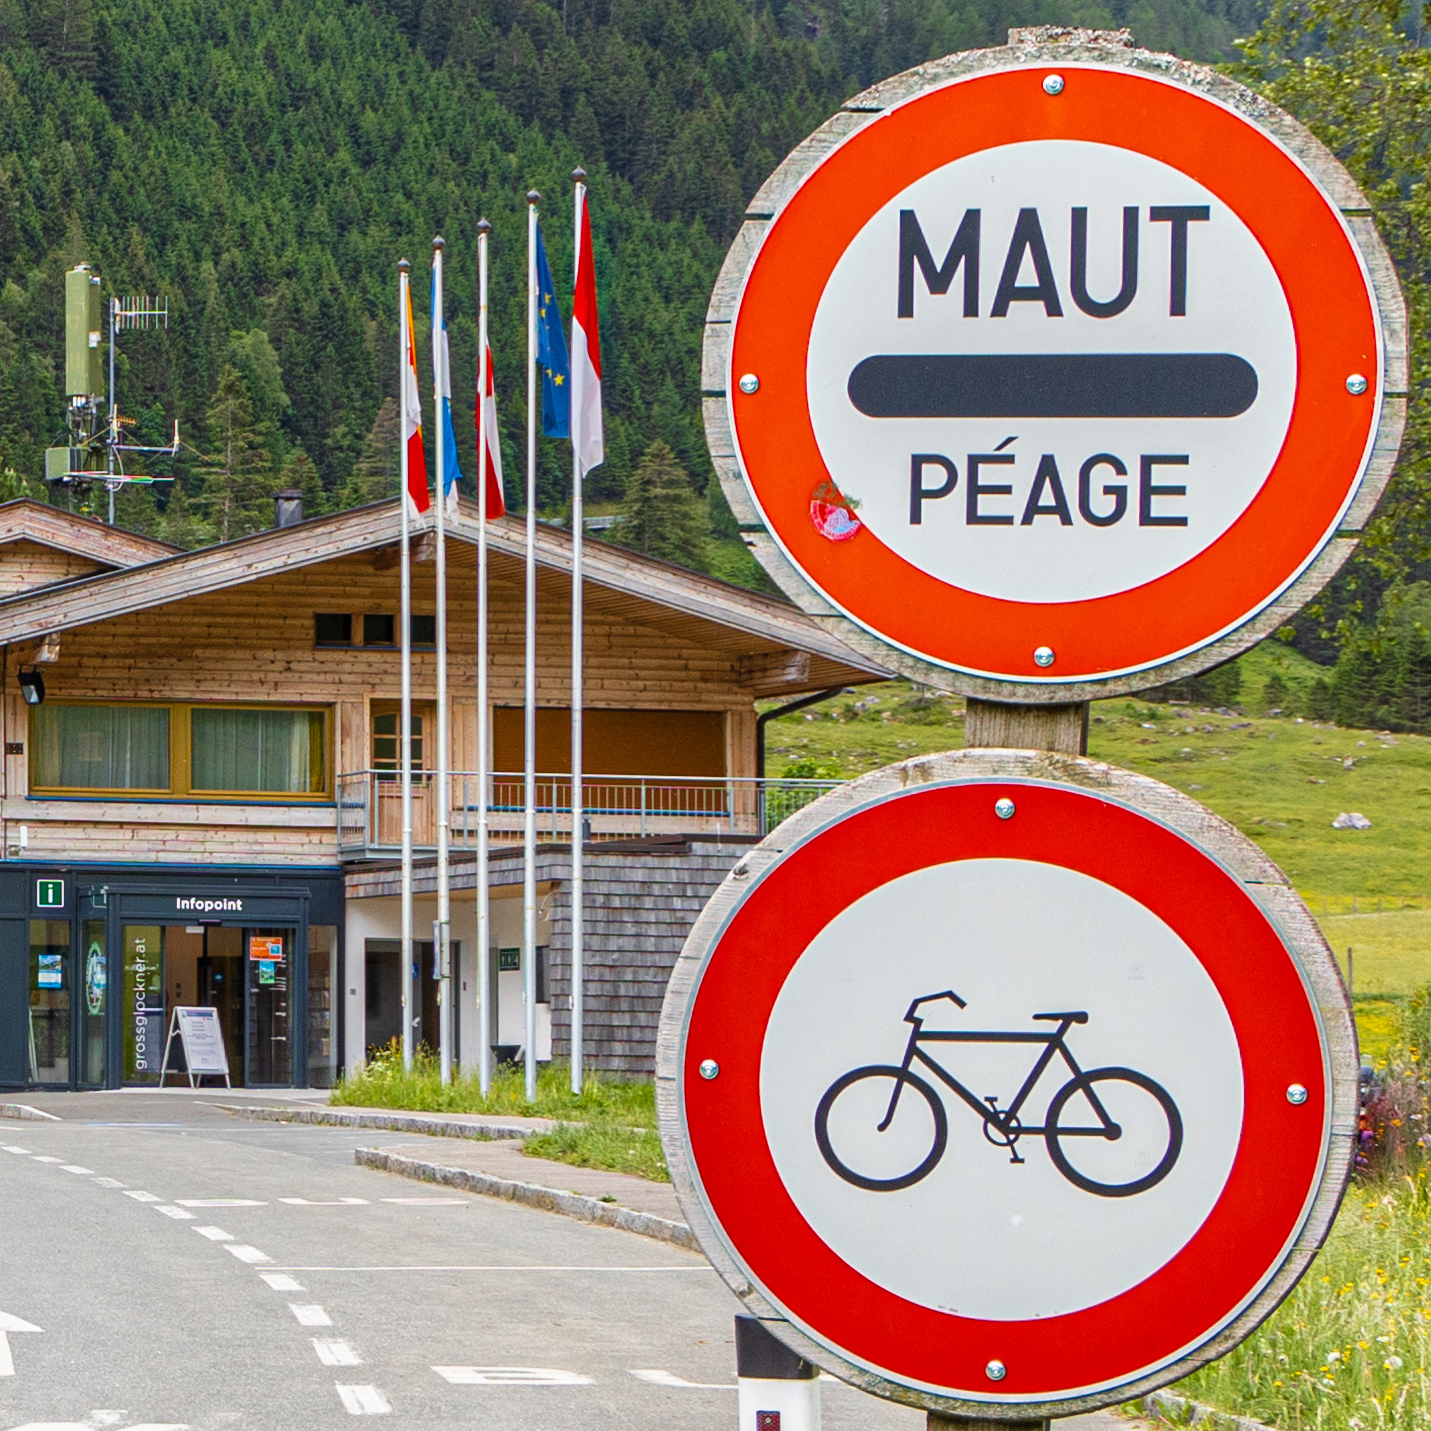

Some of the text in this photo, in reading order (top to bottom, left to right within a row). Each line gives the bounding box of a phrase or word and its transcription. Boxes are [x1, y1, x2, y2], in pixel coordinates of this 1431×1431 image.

[897, 205, 1211, 319] MAUT
[909, 435, 1190, 527] PÉAGE
[176, 897, 243, 912] Infopoint
[132, 937, 148, 1070] grossglockner.at
